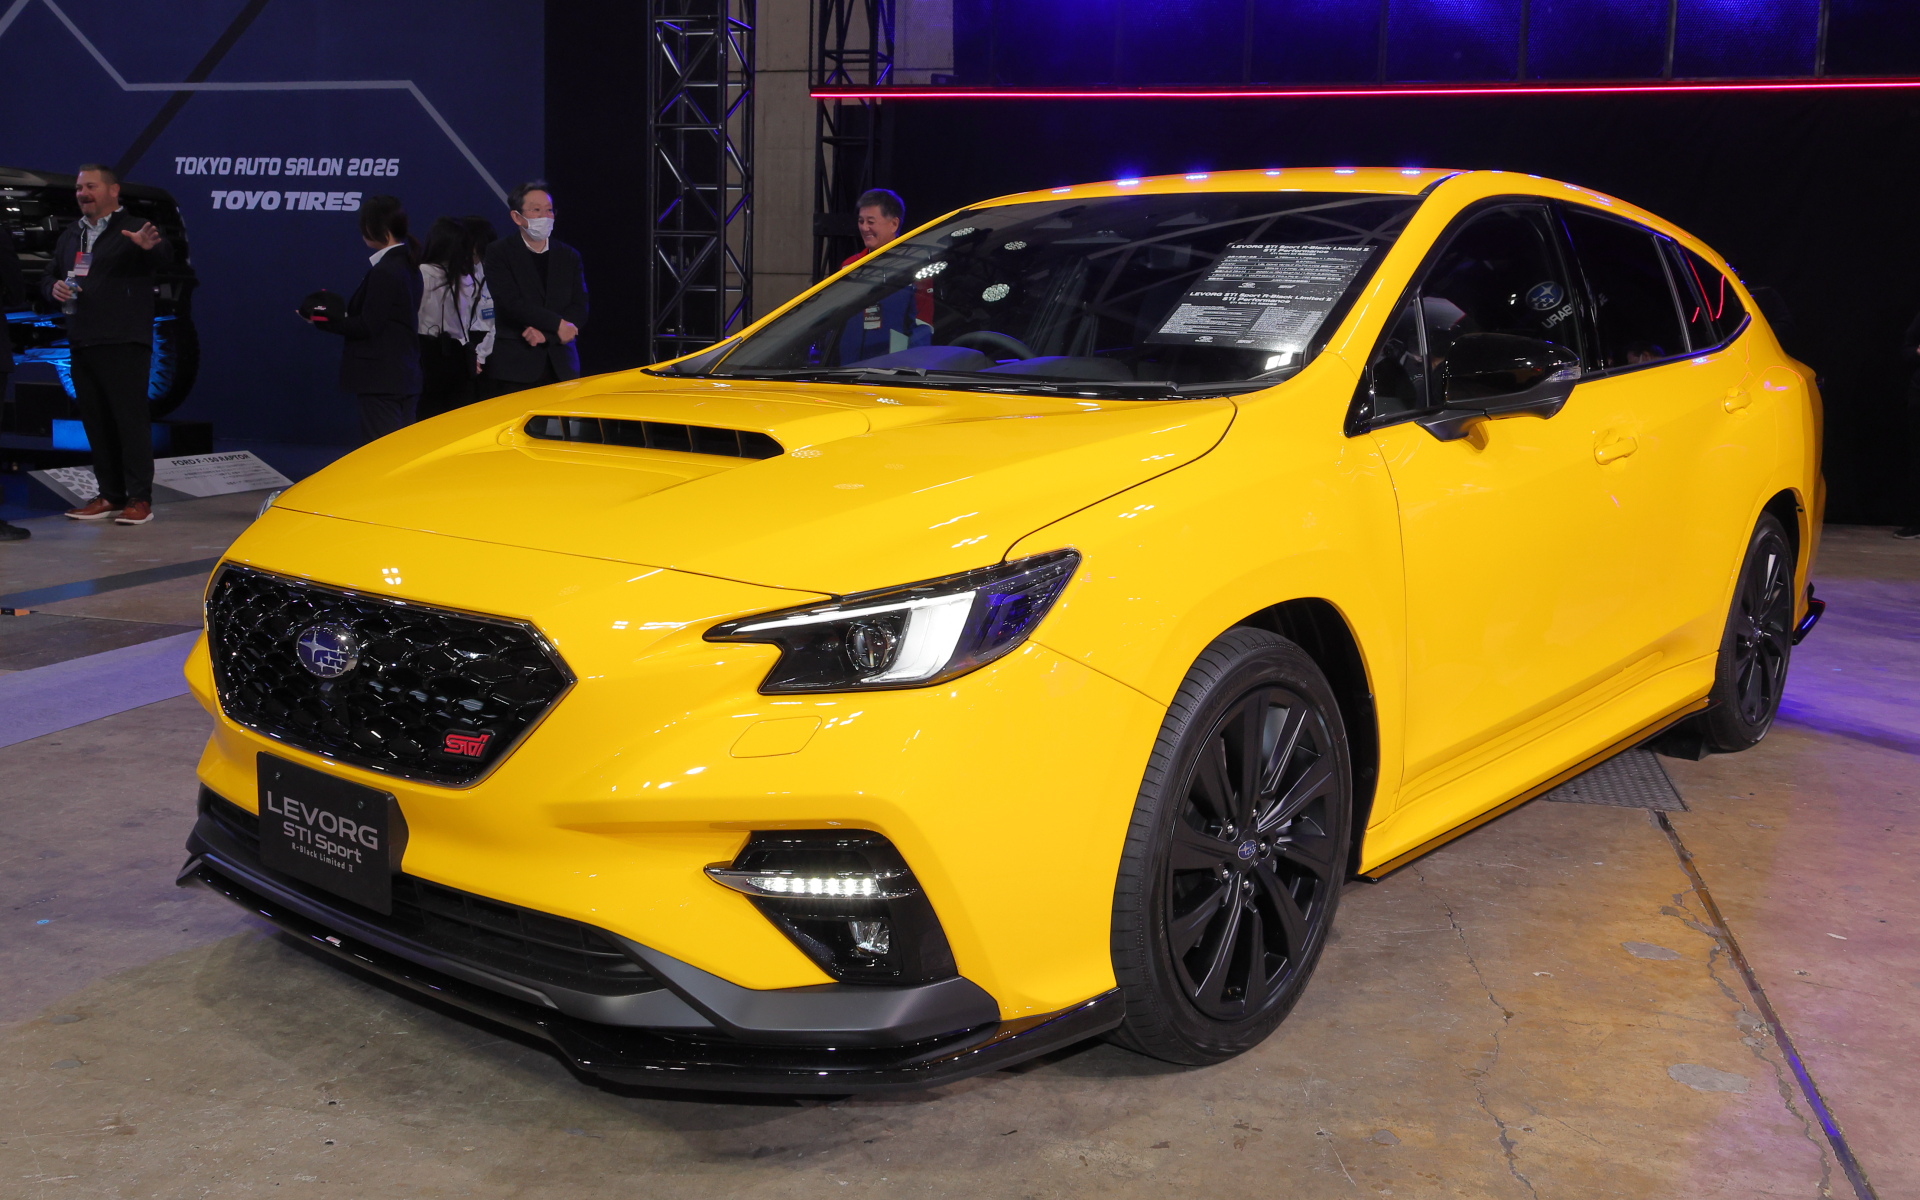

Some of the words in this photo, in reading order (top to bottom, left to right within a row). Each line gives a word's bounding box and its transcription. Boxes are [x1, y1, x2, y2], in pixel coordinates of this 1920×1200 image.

[175, 156, 232, 175] TOKYO
[234, 157, 282, 176] AUTO
[284, 157, 344, 176] SALON
[346, 158, 400, 177] 2026
[210, 190, 282, 210] TOYO
[284, 191, 363, 212] TIRES
[1237, 296, 1291, 304] Performance
[196, 456, 219, 464] F-150
[218, 453, 251, 463] RAPTOR
[267, 790, 378, 850] LEVORG
[283, 821, 312, 844] STI
[314, 832, 362, 864] Sport
[291, 841, 318, 859] R-Black
[319, 852, 346, 870] Limited
